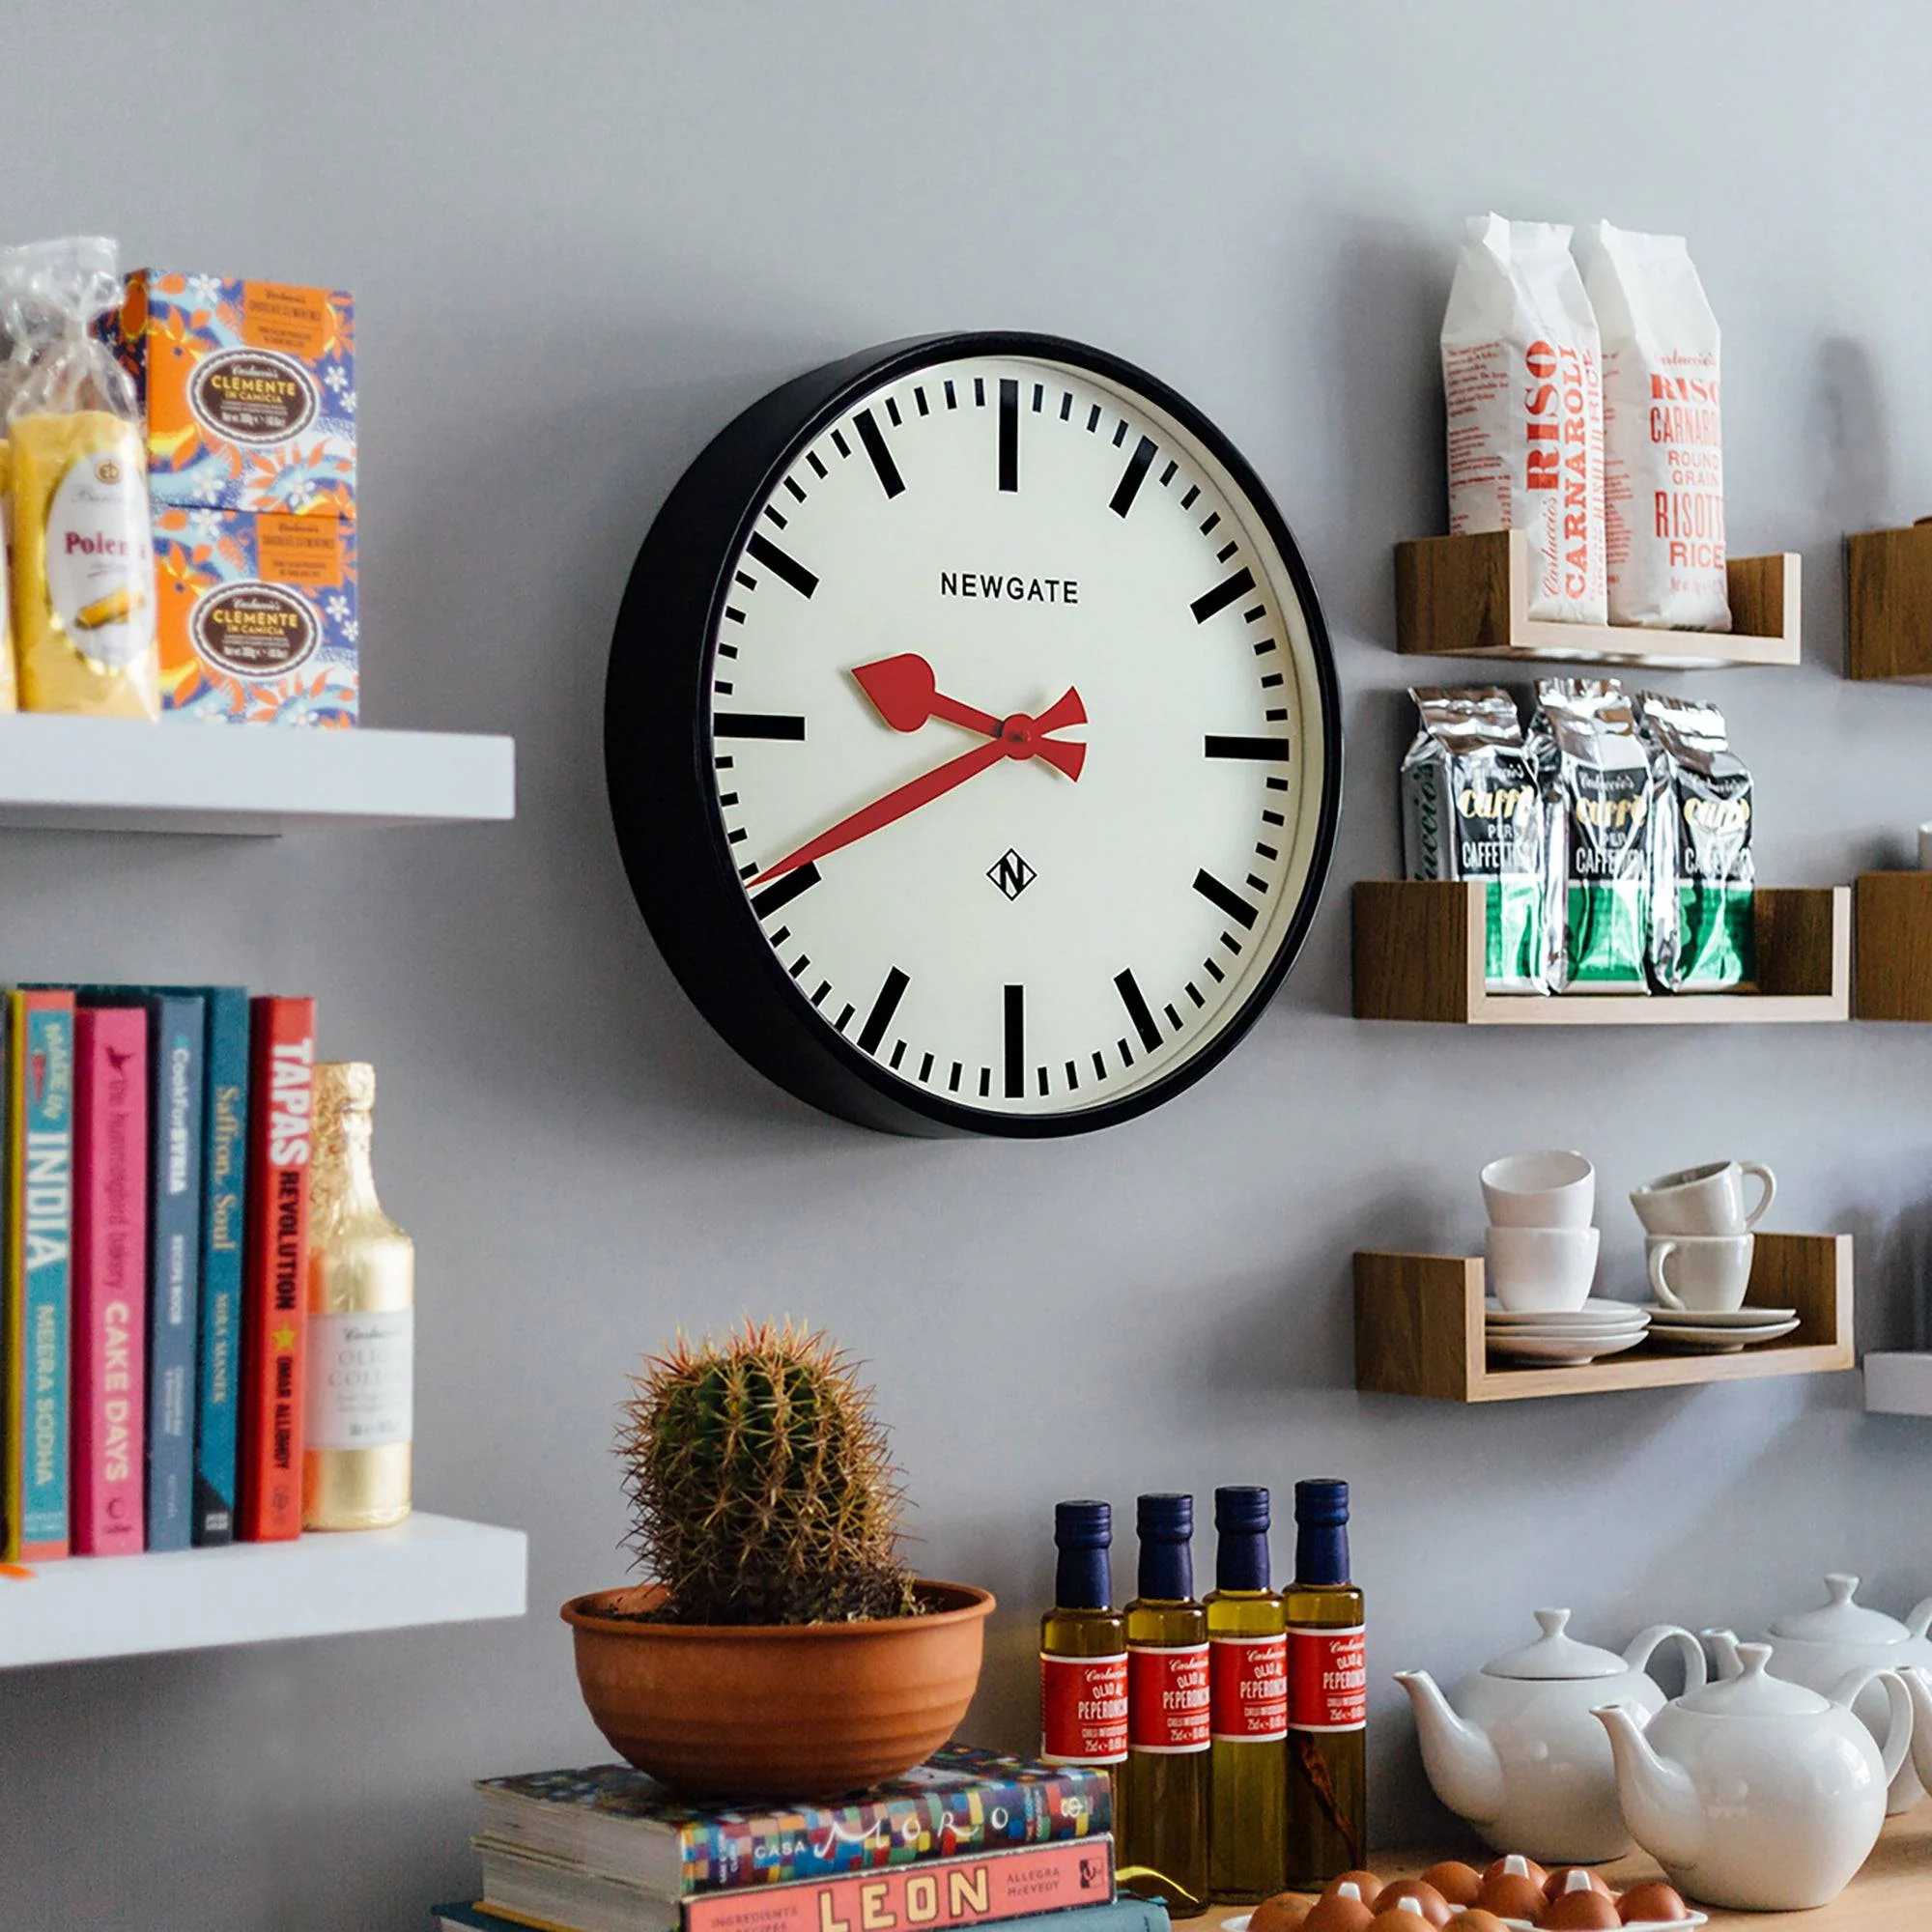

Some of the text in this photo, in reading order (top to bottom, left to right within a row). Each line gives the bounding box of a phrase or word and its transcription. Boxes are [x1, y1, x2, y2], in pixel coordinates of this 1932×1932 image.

[211, 375, 296, 397] CLEMENTE
[1525, 340, 1560, 492] RISO
[1557, 345, 1587, 600] CARNAROLI
[941, 572, 1078, 604] NEWGATE
[1540, 496, 1559, 598] Carluccio's
[1669, 541, 1724, 570] RICE
[213, 609, 298, 629] CLEMENTE
[1488, 823, 1514, 838] PR
[270, 1037, 314, 1167] TAPAS
[26, 1132, 69, 1270] INDIA
[213, 1086, 241, 1250] Saffron Soul
[276, 1170, 300, 1312] REVOLUTION
[35, 1304, 56, 1485] MEERA SODHA
[104, 1301, 129, 1483] CAKE DAYS
[754, 1839, 807, 1860] CASA
[1008, 1868, 1060, 1883] ALLEGRA
[712, 1906, 798, 1928] INGREDIENTS
[818, 1866, 991, 1932] LEON
